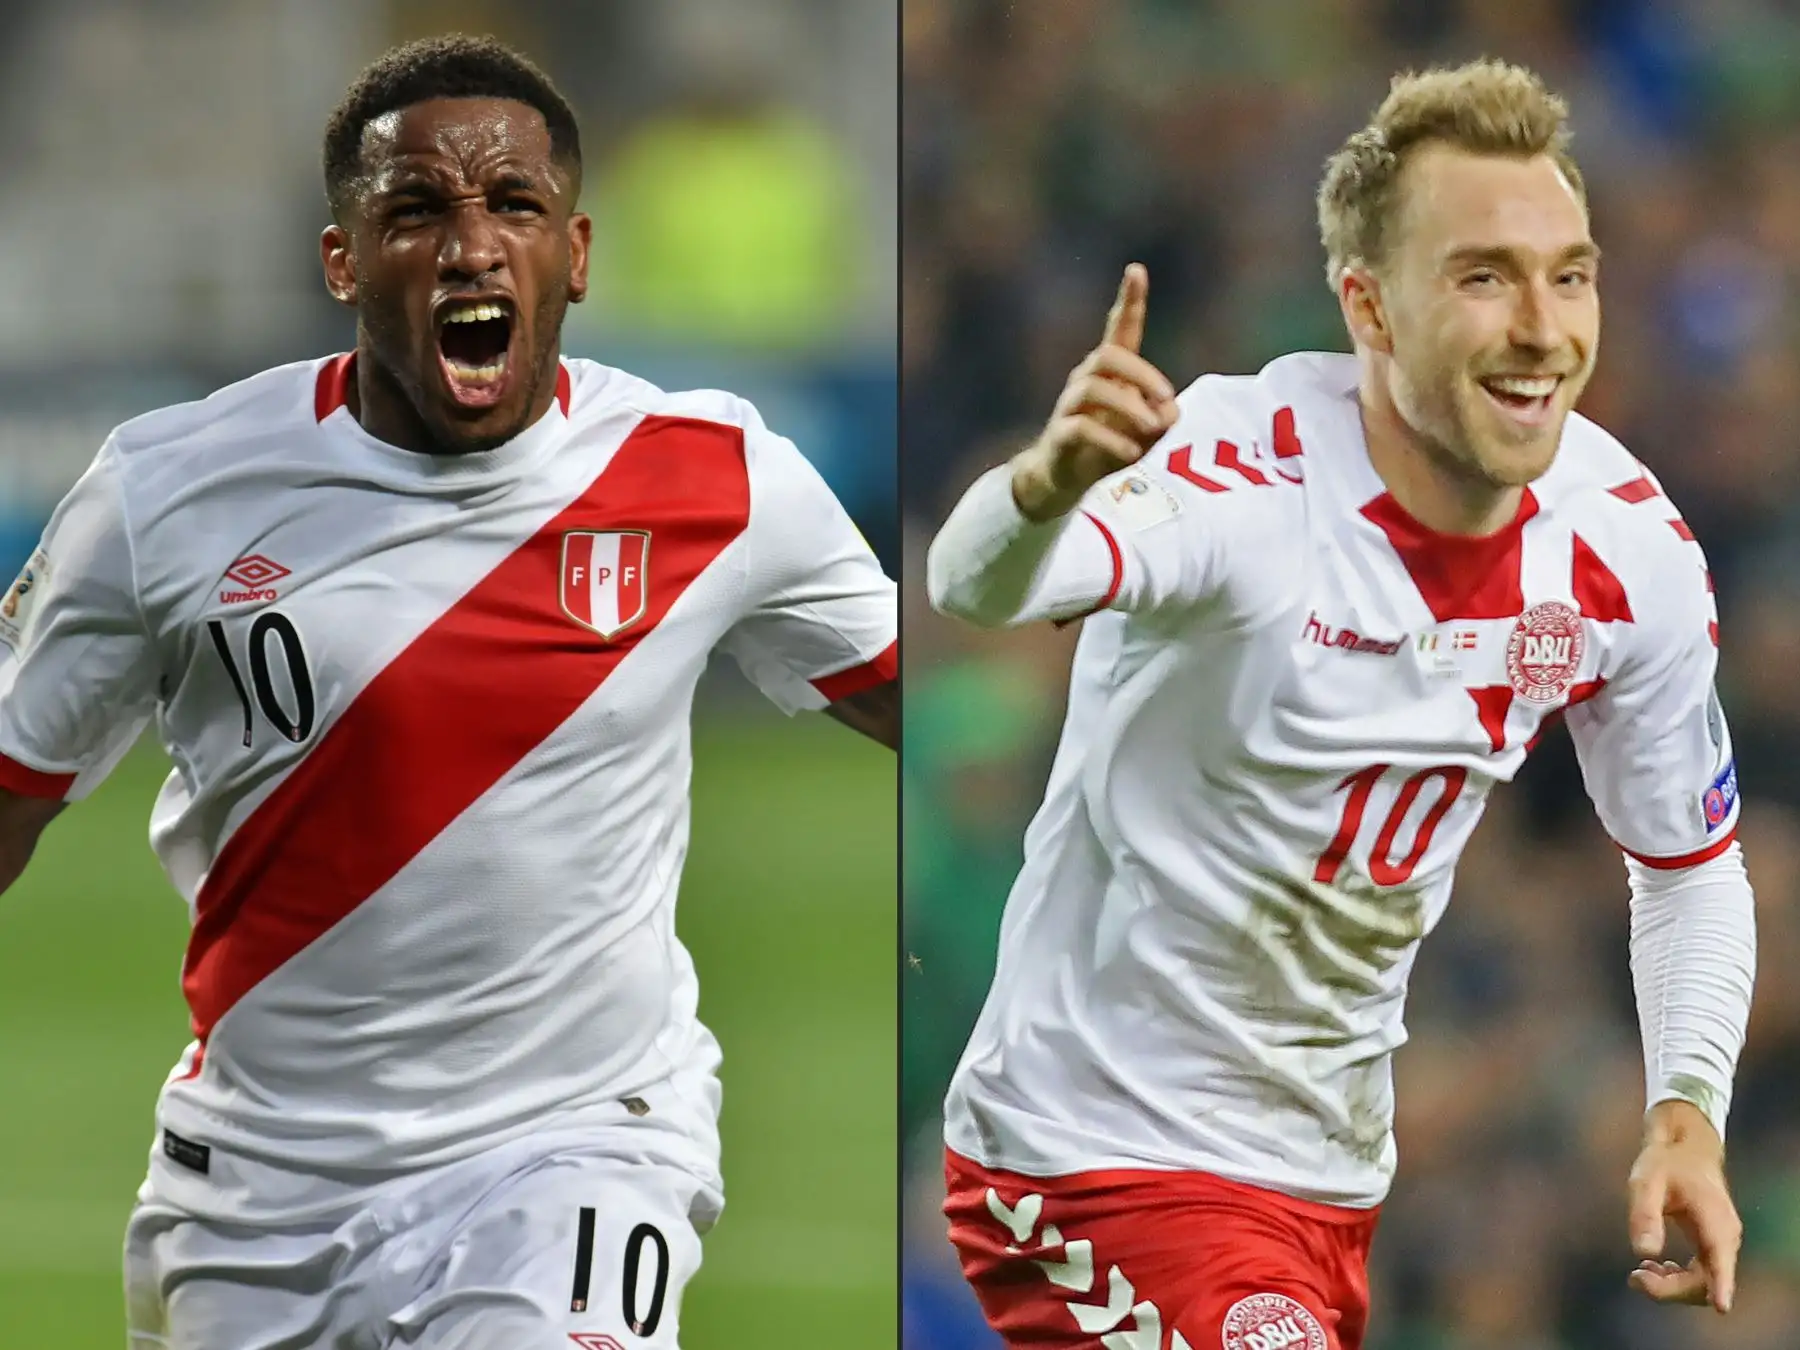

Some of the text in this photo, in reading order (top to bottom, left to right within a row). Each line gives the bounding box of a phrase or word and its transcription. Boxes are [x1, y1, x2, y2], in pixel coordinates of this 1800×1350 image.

[220, 588, 278, 604] umbro
[1302, 609, 1410, 656] huml
[207, 612, 315, 748] 10
[1522, 634, 1573, 665] DBU
[1313, 765, 1467, 888] 10
[570, 1206, 669, 1338] 10
